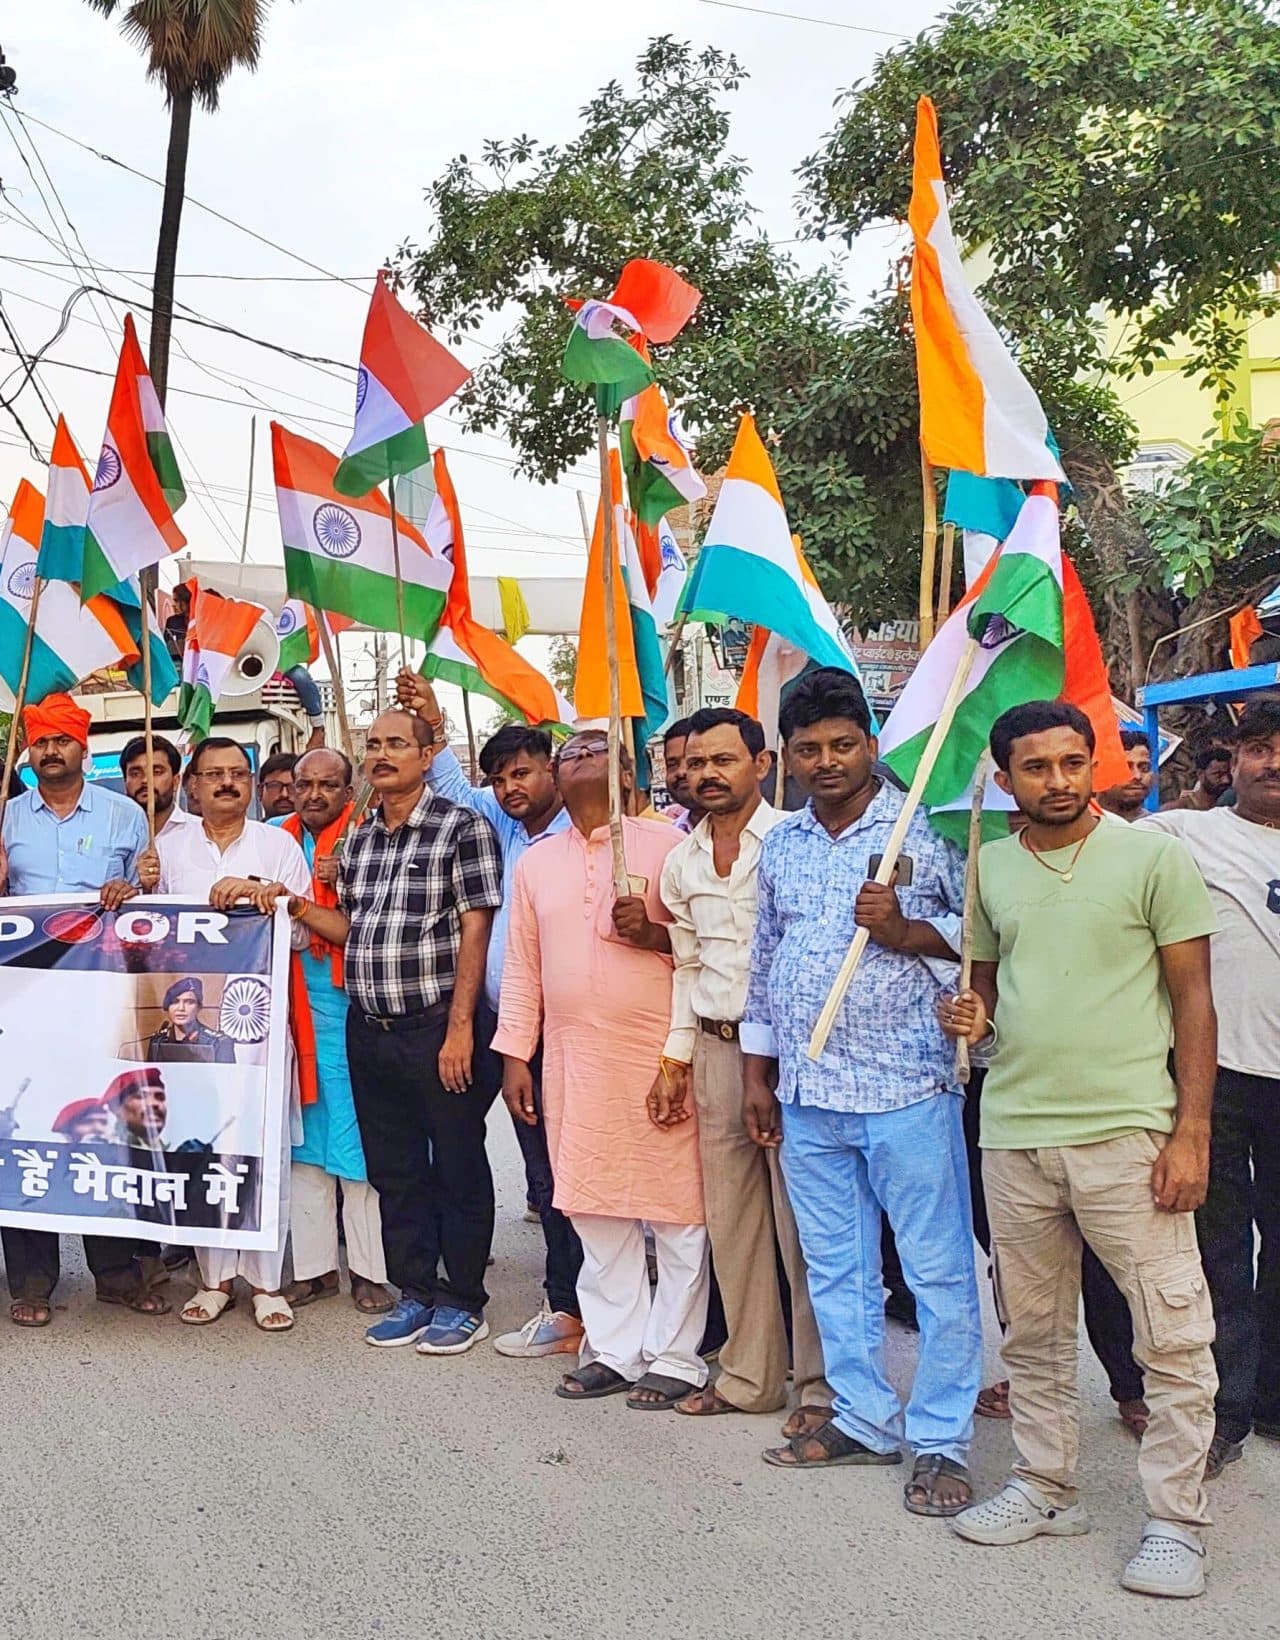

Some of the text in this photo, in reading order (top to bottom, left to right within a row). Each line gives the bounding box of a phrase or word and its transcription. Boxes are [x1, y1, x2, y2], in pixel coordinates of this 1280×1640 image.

[13, 1147, 58, 1198] हैं
[70, 1151, 189, 1210] मैदान
[202, 1162, 248, 1213] में
